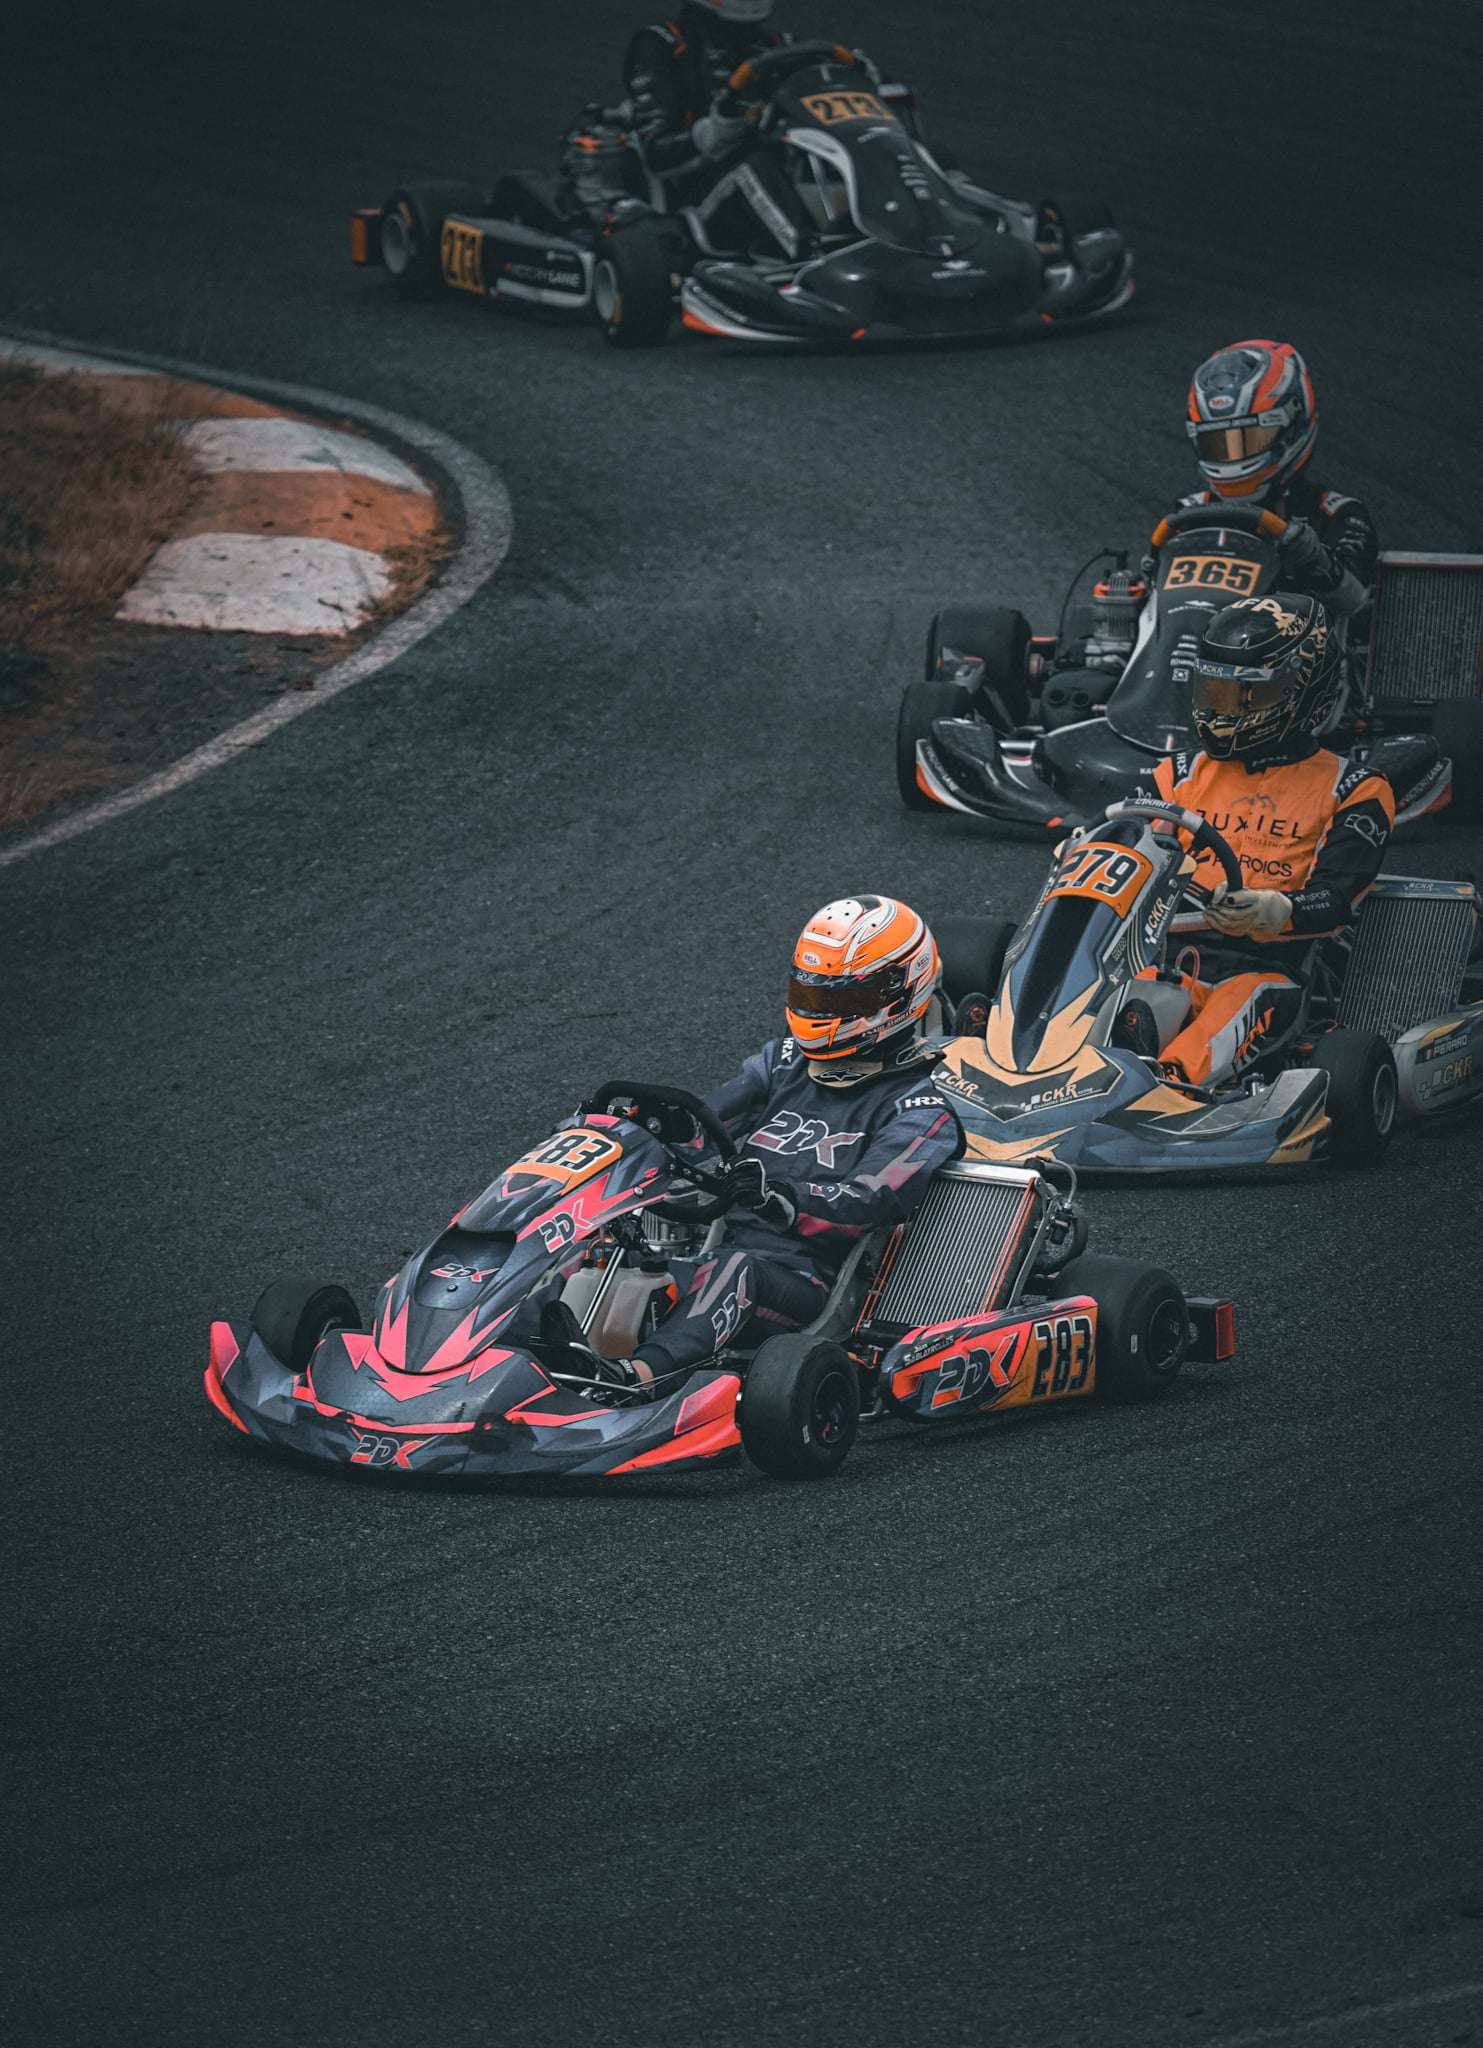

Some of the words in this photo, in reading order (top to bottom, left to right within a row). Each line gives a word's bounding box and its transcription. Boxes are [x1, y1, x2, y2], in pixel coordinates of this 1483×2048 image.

[1169, 560, 1254, 593] 365
[1052, 848, 1140, 896] 279
[1212, 854, 1293, 878] ROICS
[1148, 897, 1170, 929] CKR
[945, 1075, 979, 1098] CKR
[1041, 1084, 1078, 1103] CKR
[904, 1096, 944, 1107] HRX
[1032, 1314, 1094, 1398] 283
